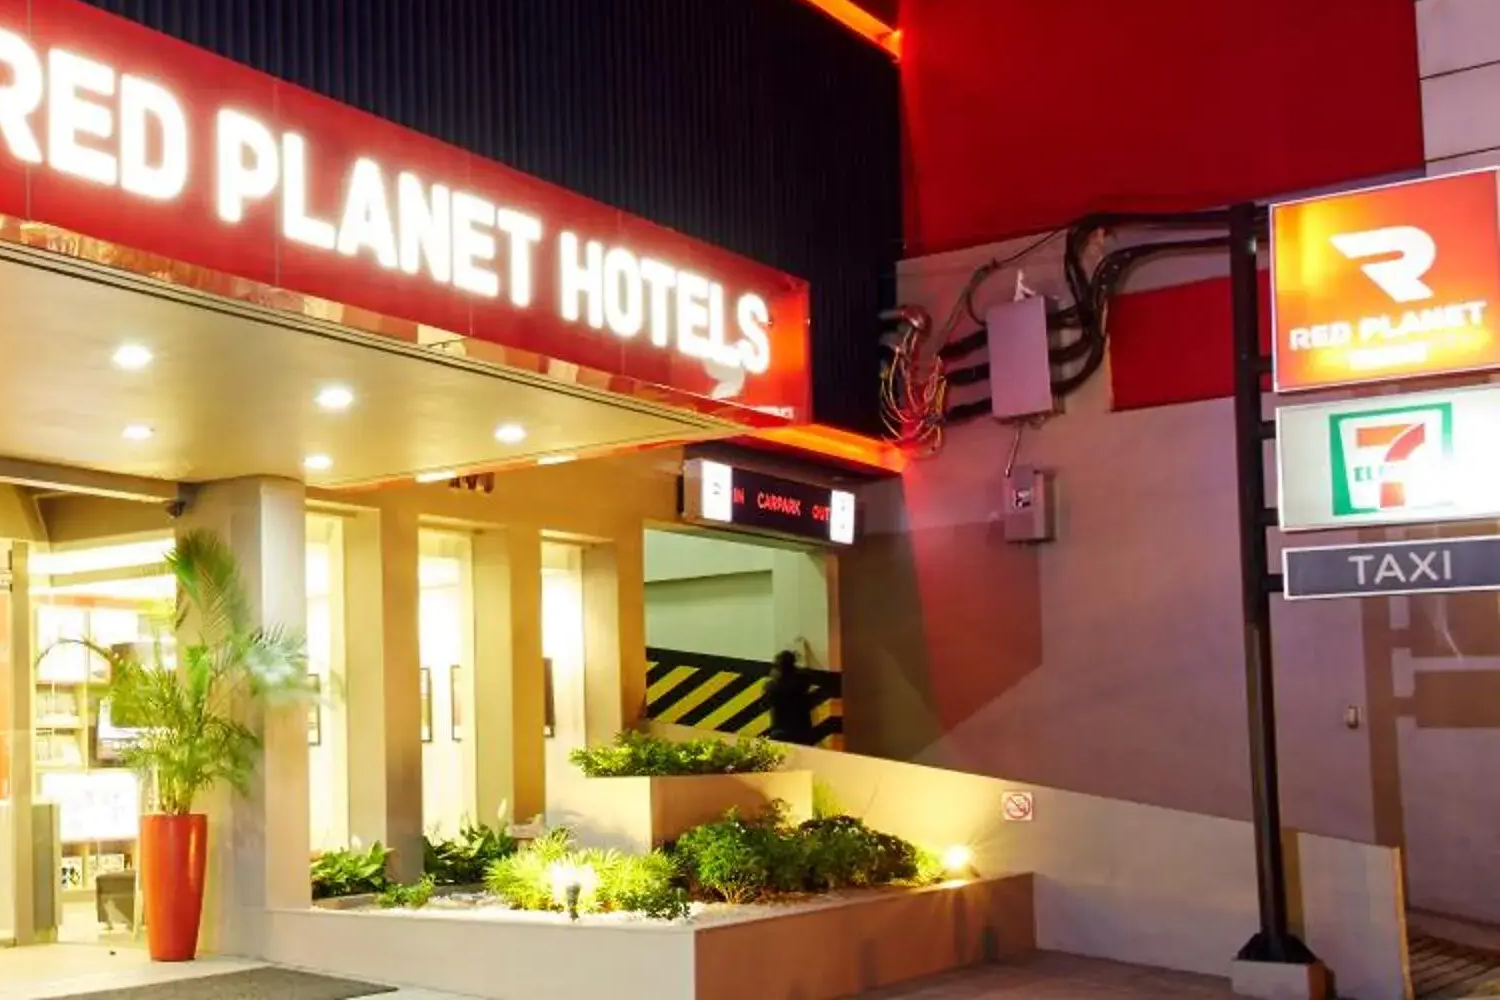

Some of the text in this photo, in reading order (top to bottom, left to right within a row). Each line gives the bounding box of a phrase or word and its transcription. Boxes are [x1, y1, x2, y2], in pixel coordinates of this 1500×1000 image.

[216, 106, 542, 309] PLANET
[559, 230, 771, 375] HOTELS
[1288, 300, 1488, 352] RED PLANET
[756, 491, 801, 517] CARPARK
[1348, 550, 1452, 586] TAXI
